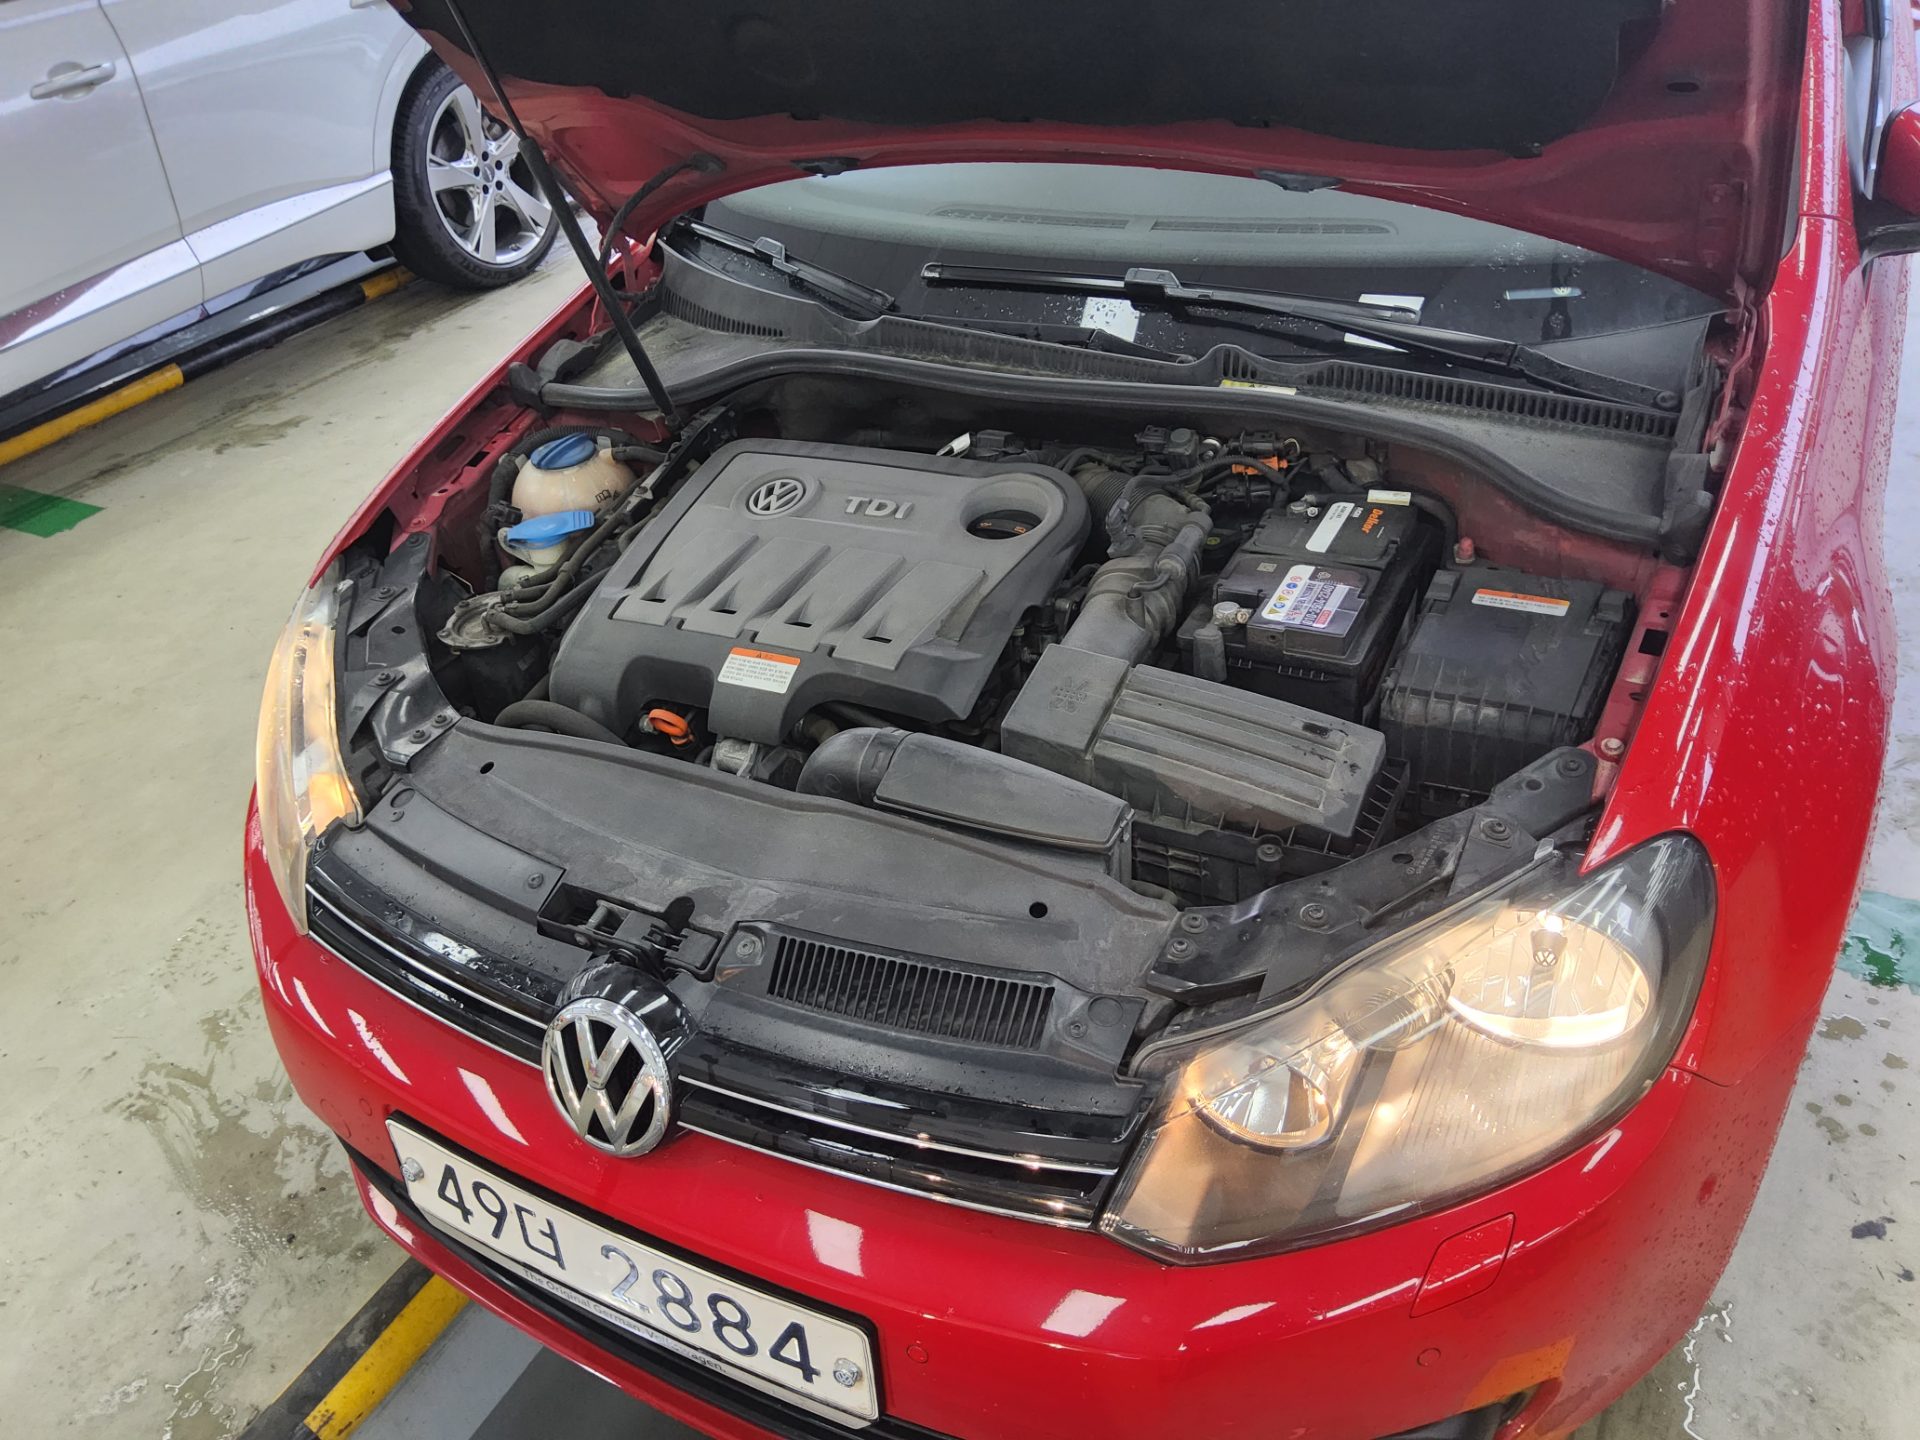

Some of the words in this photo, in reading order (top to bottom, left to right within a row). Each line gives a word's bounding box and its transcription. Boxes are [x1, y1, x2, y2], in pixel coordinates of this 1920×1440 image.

[750, 478, 804, 515] VW
[845, 496, 914, 519] TDI
[542, 997, 672, 1158] VW
[437, 1163, 566, 1270] 49더
[600, 1244, 821, 1383] 2884
[523, 1268, 544, 1285] The
[546, 1280, 591, 1309] Original
